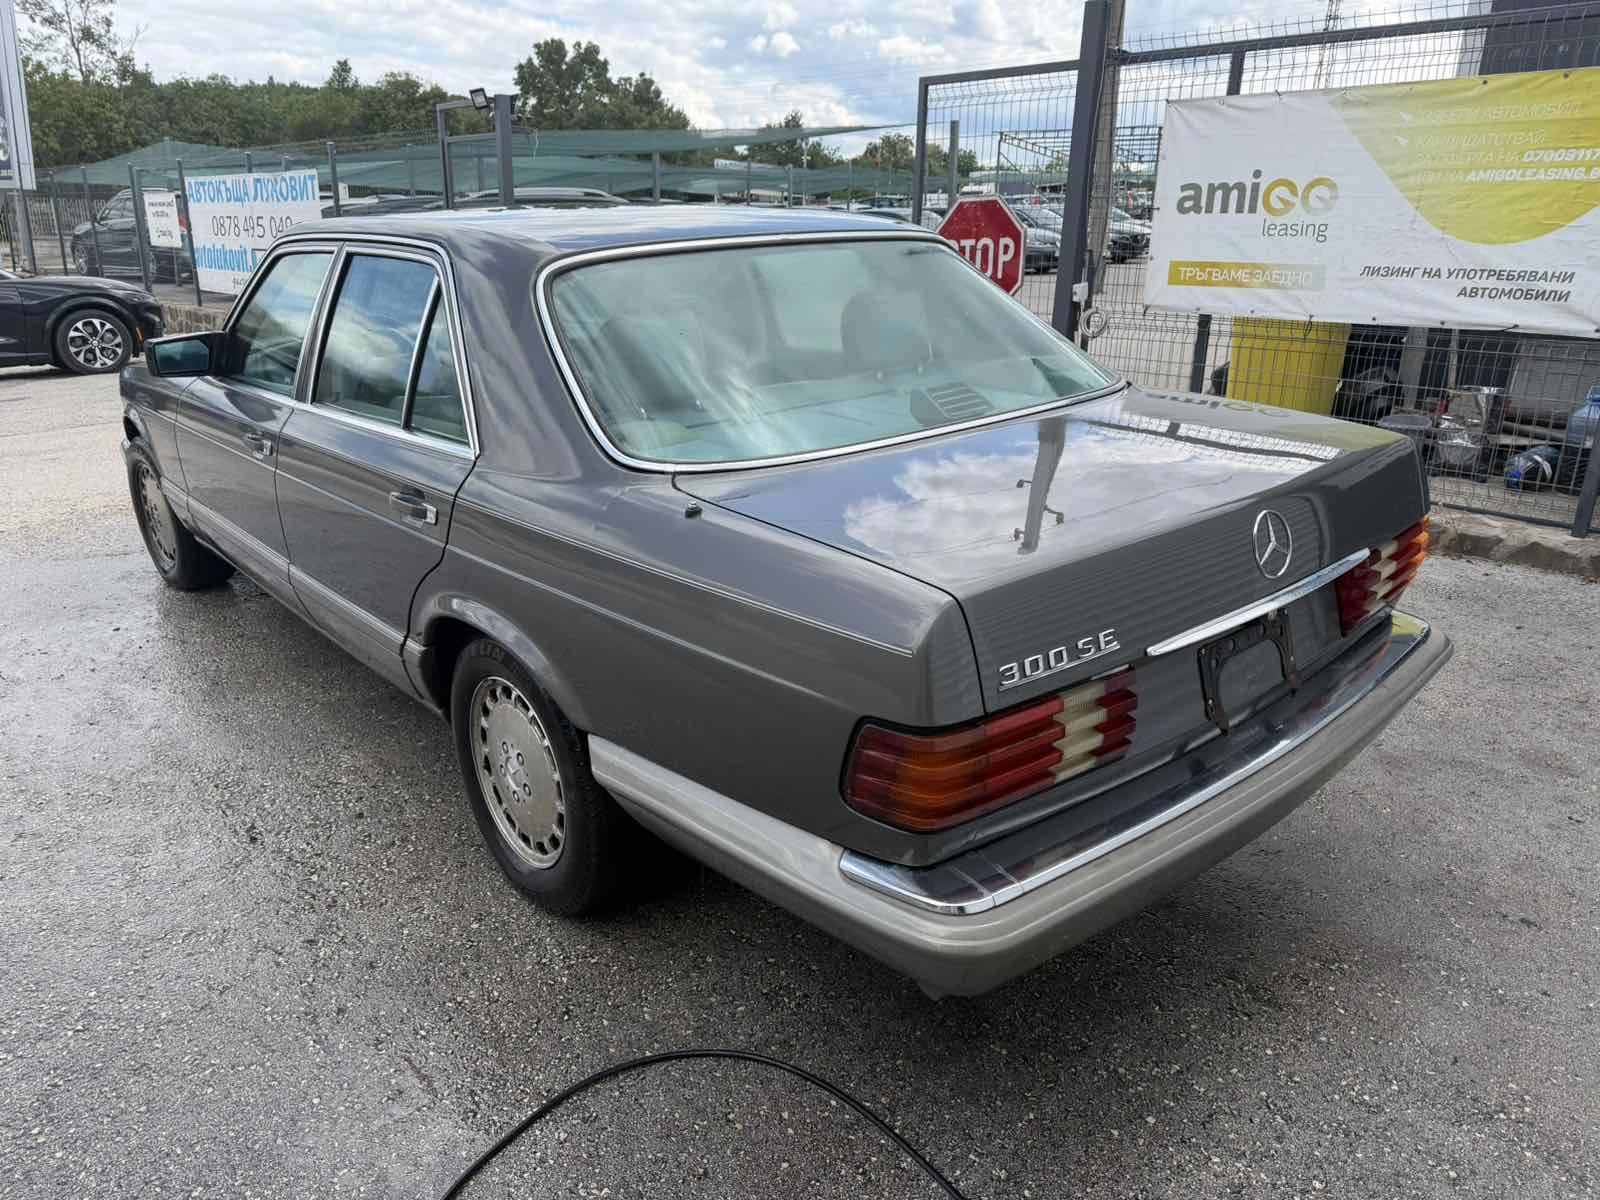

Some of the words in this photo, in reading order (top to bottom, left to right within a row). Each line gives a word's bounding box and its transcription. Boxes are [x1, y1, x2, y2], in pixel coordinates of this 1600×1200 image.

[187, 177, 249, 206] АВТОКЪЩА
[253, 175, 317, 202] ЛУКОВИТ
[212, 216, 240, 238] 0878
[243, 216, 265, 239] 495
[1262, 218, 1329, 243] leasing
[948, 237, 1015, 279] TOP
[1179, 267, 1249, 282] ТРЪГВАМЕ
[1360, 266, 1420, 279] ЛИЗИНГ
[1421, 267, 1442, 280] НА
[1446, 268, 1576, 284] УПОТРЕБЯВАНИ
[1457, 286, 1571, 302] АВТОМОБИЛИ
[999, 646, 1068, 685] 300
[1077, 628, 1118, 657] SE
